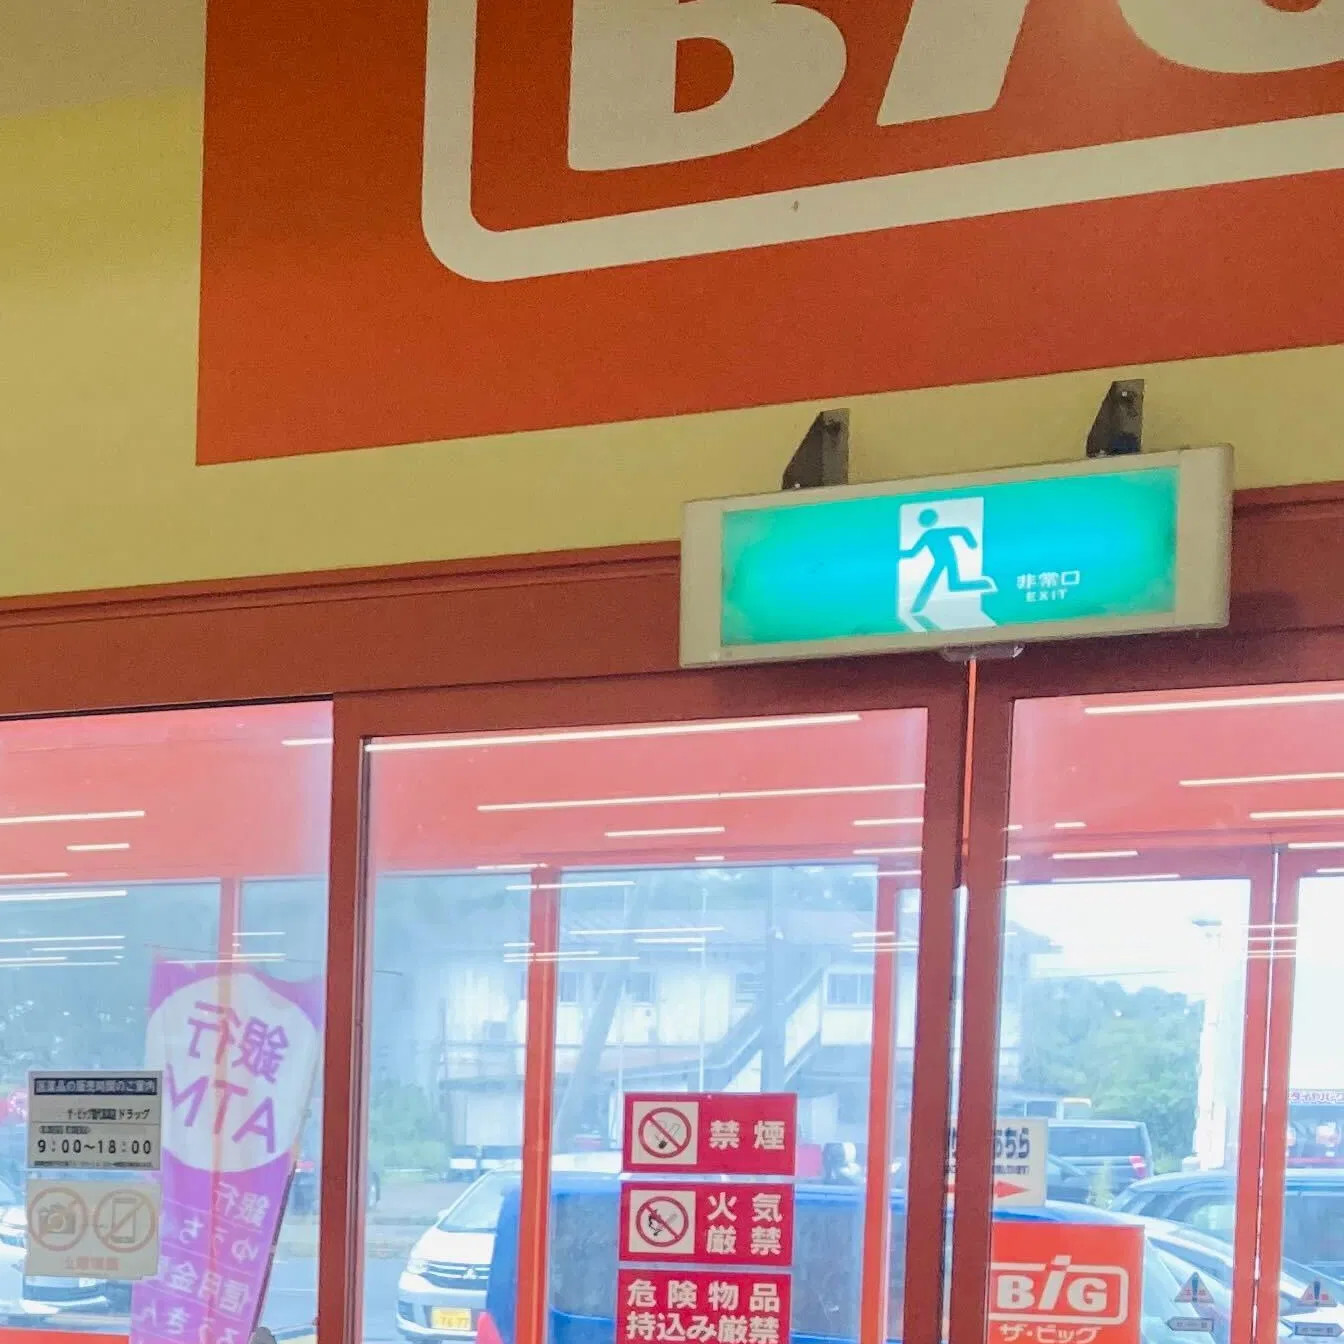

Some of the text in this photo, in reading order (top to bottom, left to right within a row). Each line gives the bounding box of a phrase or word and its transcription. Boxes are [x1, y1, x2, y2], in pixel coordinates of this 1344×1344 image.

[1017, 570, 1080, 589] 非常口
[1026, 589, 1067, 602] EXIT
[708, 1120, 785, 1150] 禁煙
[707, 1192, 783, 1222] 火気
[706, 1225, 781, 1255] 厳禁
[627, 1279, 780, 1313] 危険物品
[1000, 1322, 1102, 1344] ザ・ビッグ
